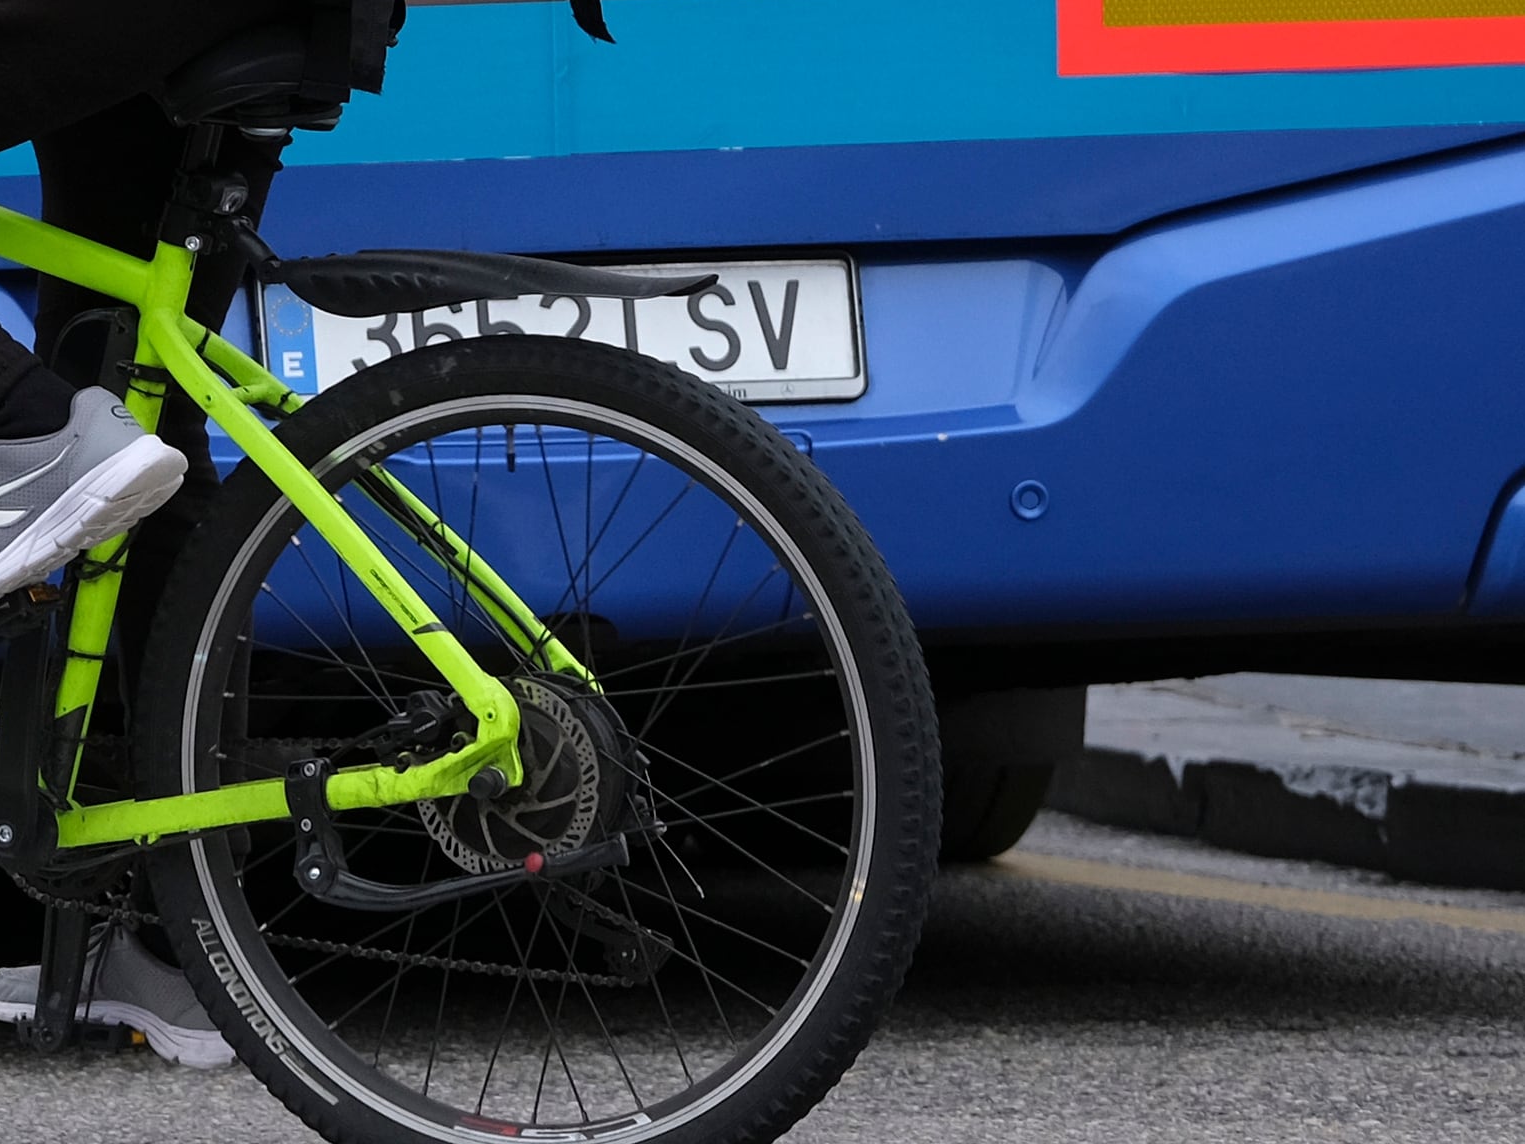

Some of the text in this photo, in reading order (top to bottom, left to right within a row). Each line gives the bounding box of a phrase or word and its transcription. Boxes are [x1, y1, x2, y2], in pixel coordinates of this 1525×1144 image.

[283, 352, 304, 378] E
[191, 917, 291, 1056] ALL CONDITIONS
